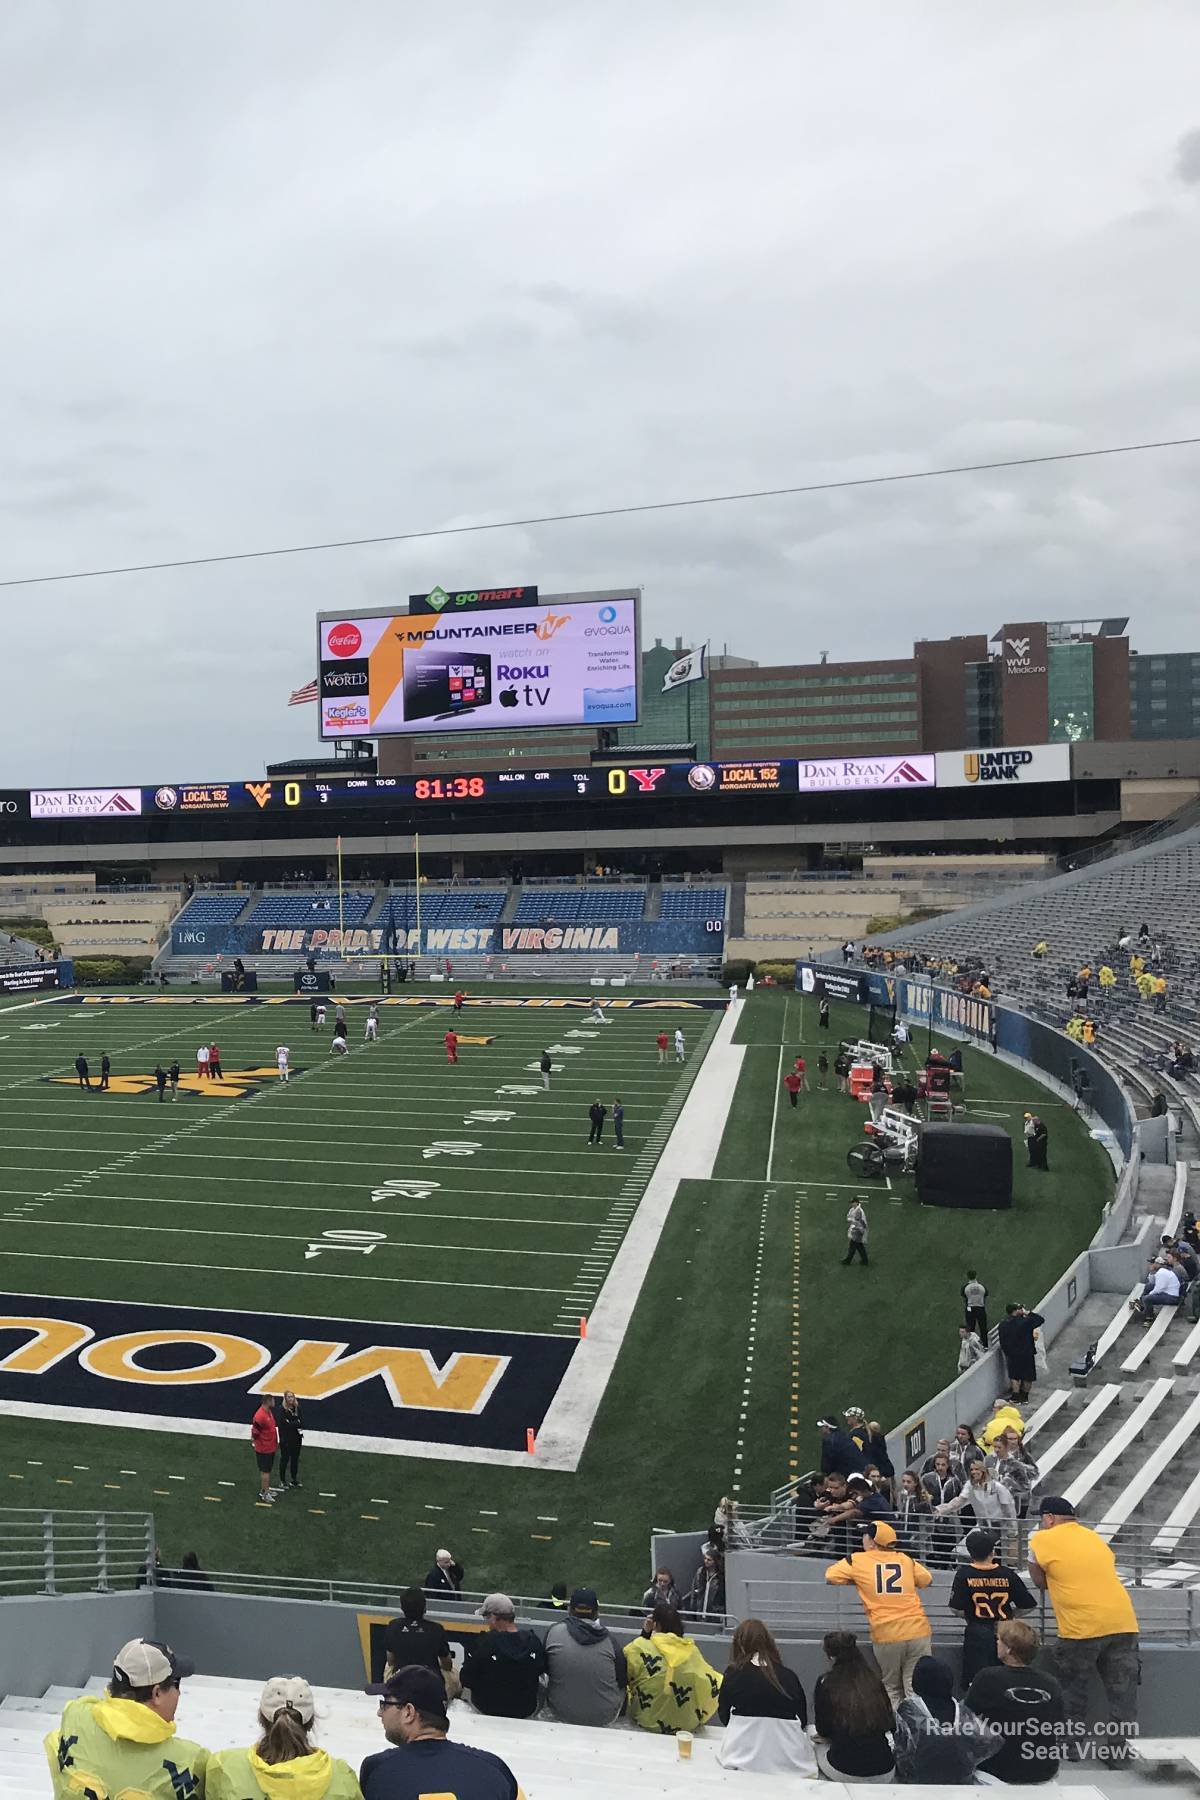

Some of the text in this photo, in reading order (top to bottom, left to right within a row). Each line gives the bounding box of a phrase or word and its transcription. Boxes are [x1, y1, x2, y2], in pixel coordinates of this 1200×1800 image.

[455, 587, 525, 606] gomart
[407, 622, 537, 641] MOUNTAINEER
[1007, 658, 1030, 666] WVU
[1008, 666, 1046, 675] Medicine
[324, 675, 367, 687] WORLD
[523, 685, 551, 706] tv
[328, 707, 367, 719] Kegler's
[587, 702, 632, 711] evoqua.com
[980, 751, 1033, 767] UNITED
[534, 772, 550, 780] QTR
[723, 768, 778, 782] LOCAL 152
[980, 766, 1019, 780] BANK
[415, 777, 484, 799] 81:38
[577, 783, 586, 793] 3
[608, 769, 626, 794] 0
[810, 776, 880, 787] BUILDERS
[183, 790, 227, 803] LOCAL 152
[284, 782, 300, 806] 0
[320, 794, 328, 803] 3
[40, 806, 98, 814] BUILDERS
[706, 920, 722, 932] 00
[178, 929, 205, 943] IMG
[262, 928, 618, 951] THE PRIDE OF WEST VIRGINIA
[940, 991, 990, 1034] VIRGINIA
[307, 1229, 387, 1257] 10
[910, 1430, 921, 1457] 101
[875, 1561, 903, 1596] 12
[967, 1577, 1010, 1588] MOUNTAINEERS
[972, 1592, 1009, 1619] 67
